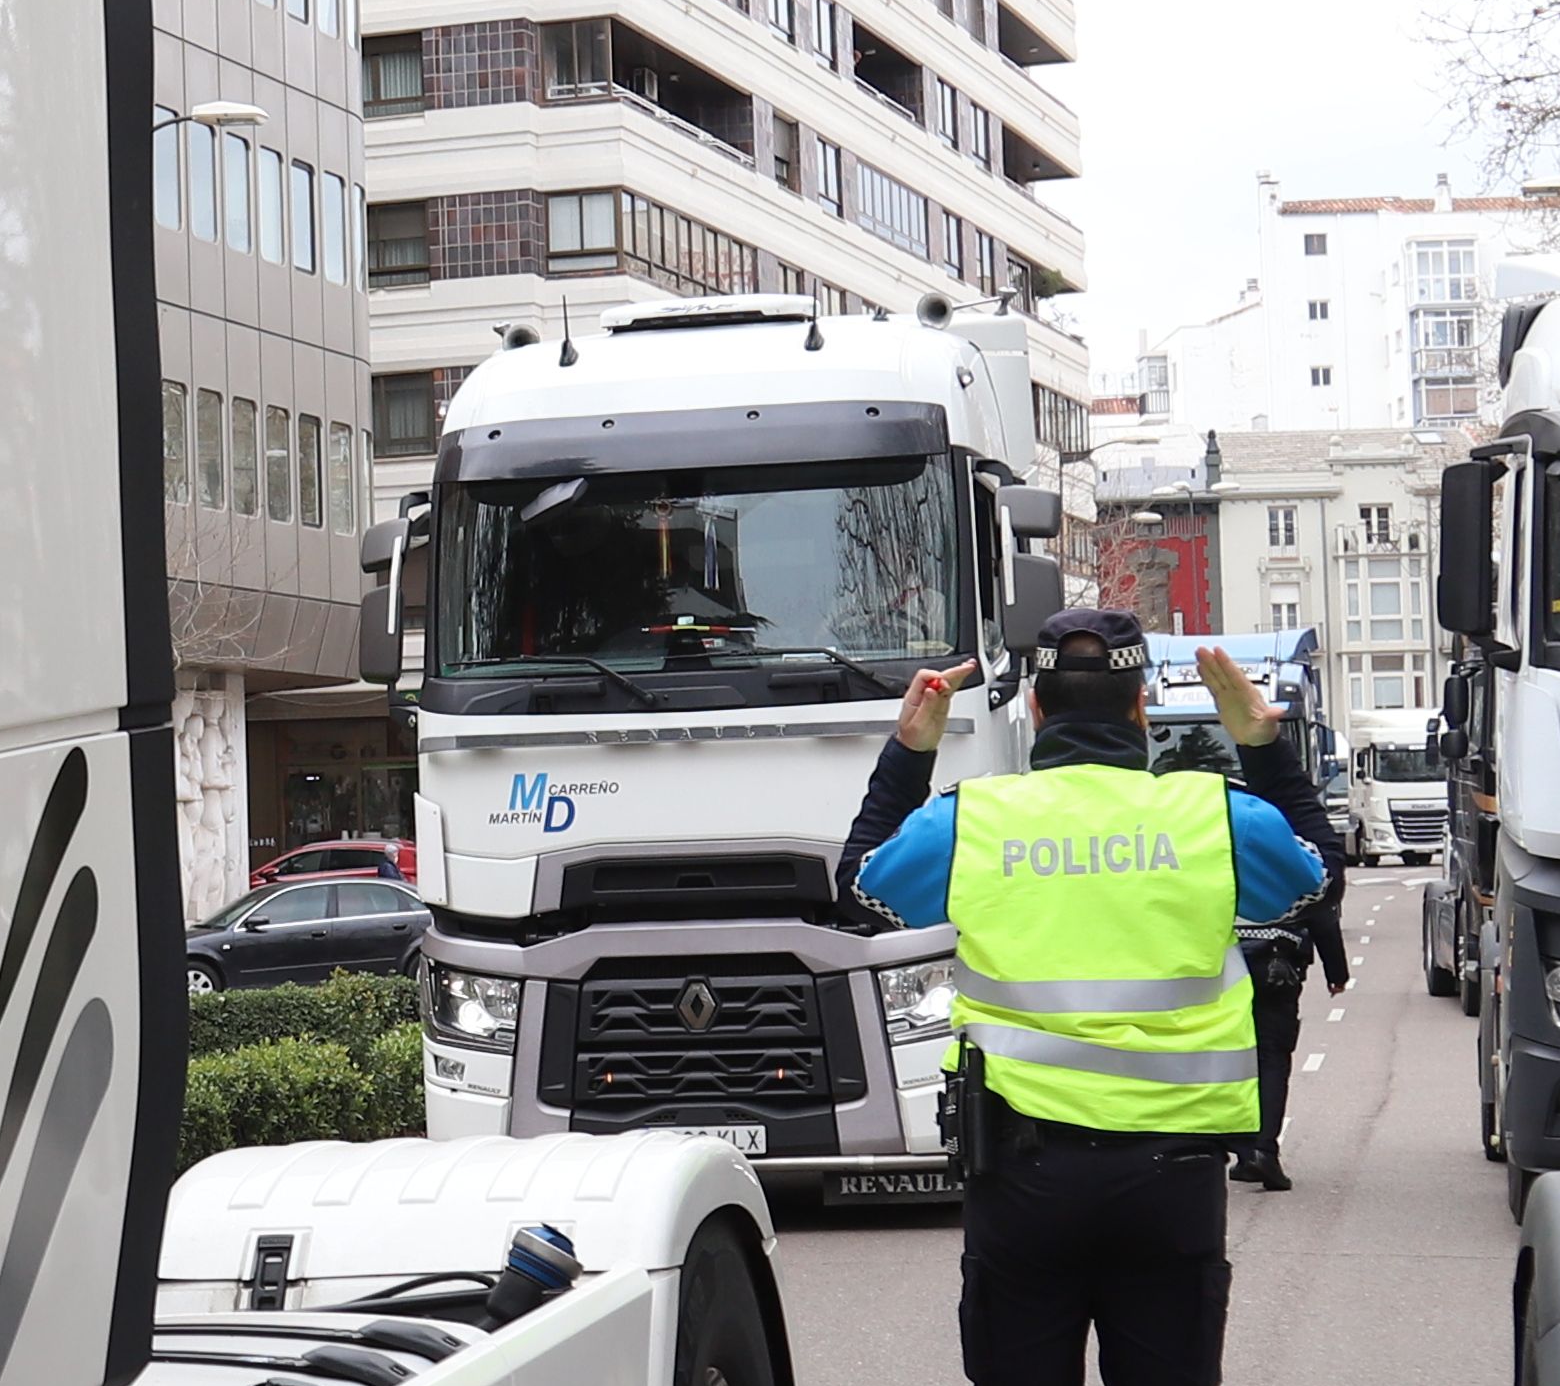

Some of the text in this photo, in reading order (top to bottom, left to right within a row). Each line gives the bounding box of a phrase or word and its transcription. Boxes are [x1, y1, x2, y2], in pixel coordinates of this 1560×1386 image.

[584, 722, 787, 745] RENAULT
[508, 772, 620, 811] M CARREÑO
[488, 795, 576, 834] MARTÍN D
[1002, 824, 1180, 878] POLICÍA
[839, 1173, 964, 1195] RENAUL
